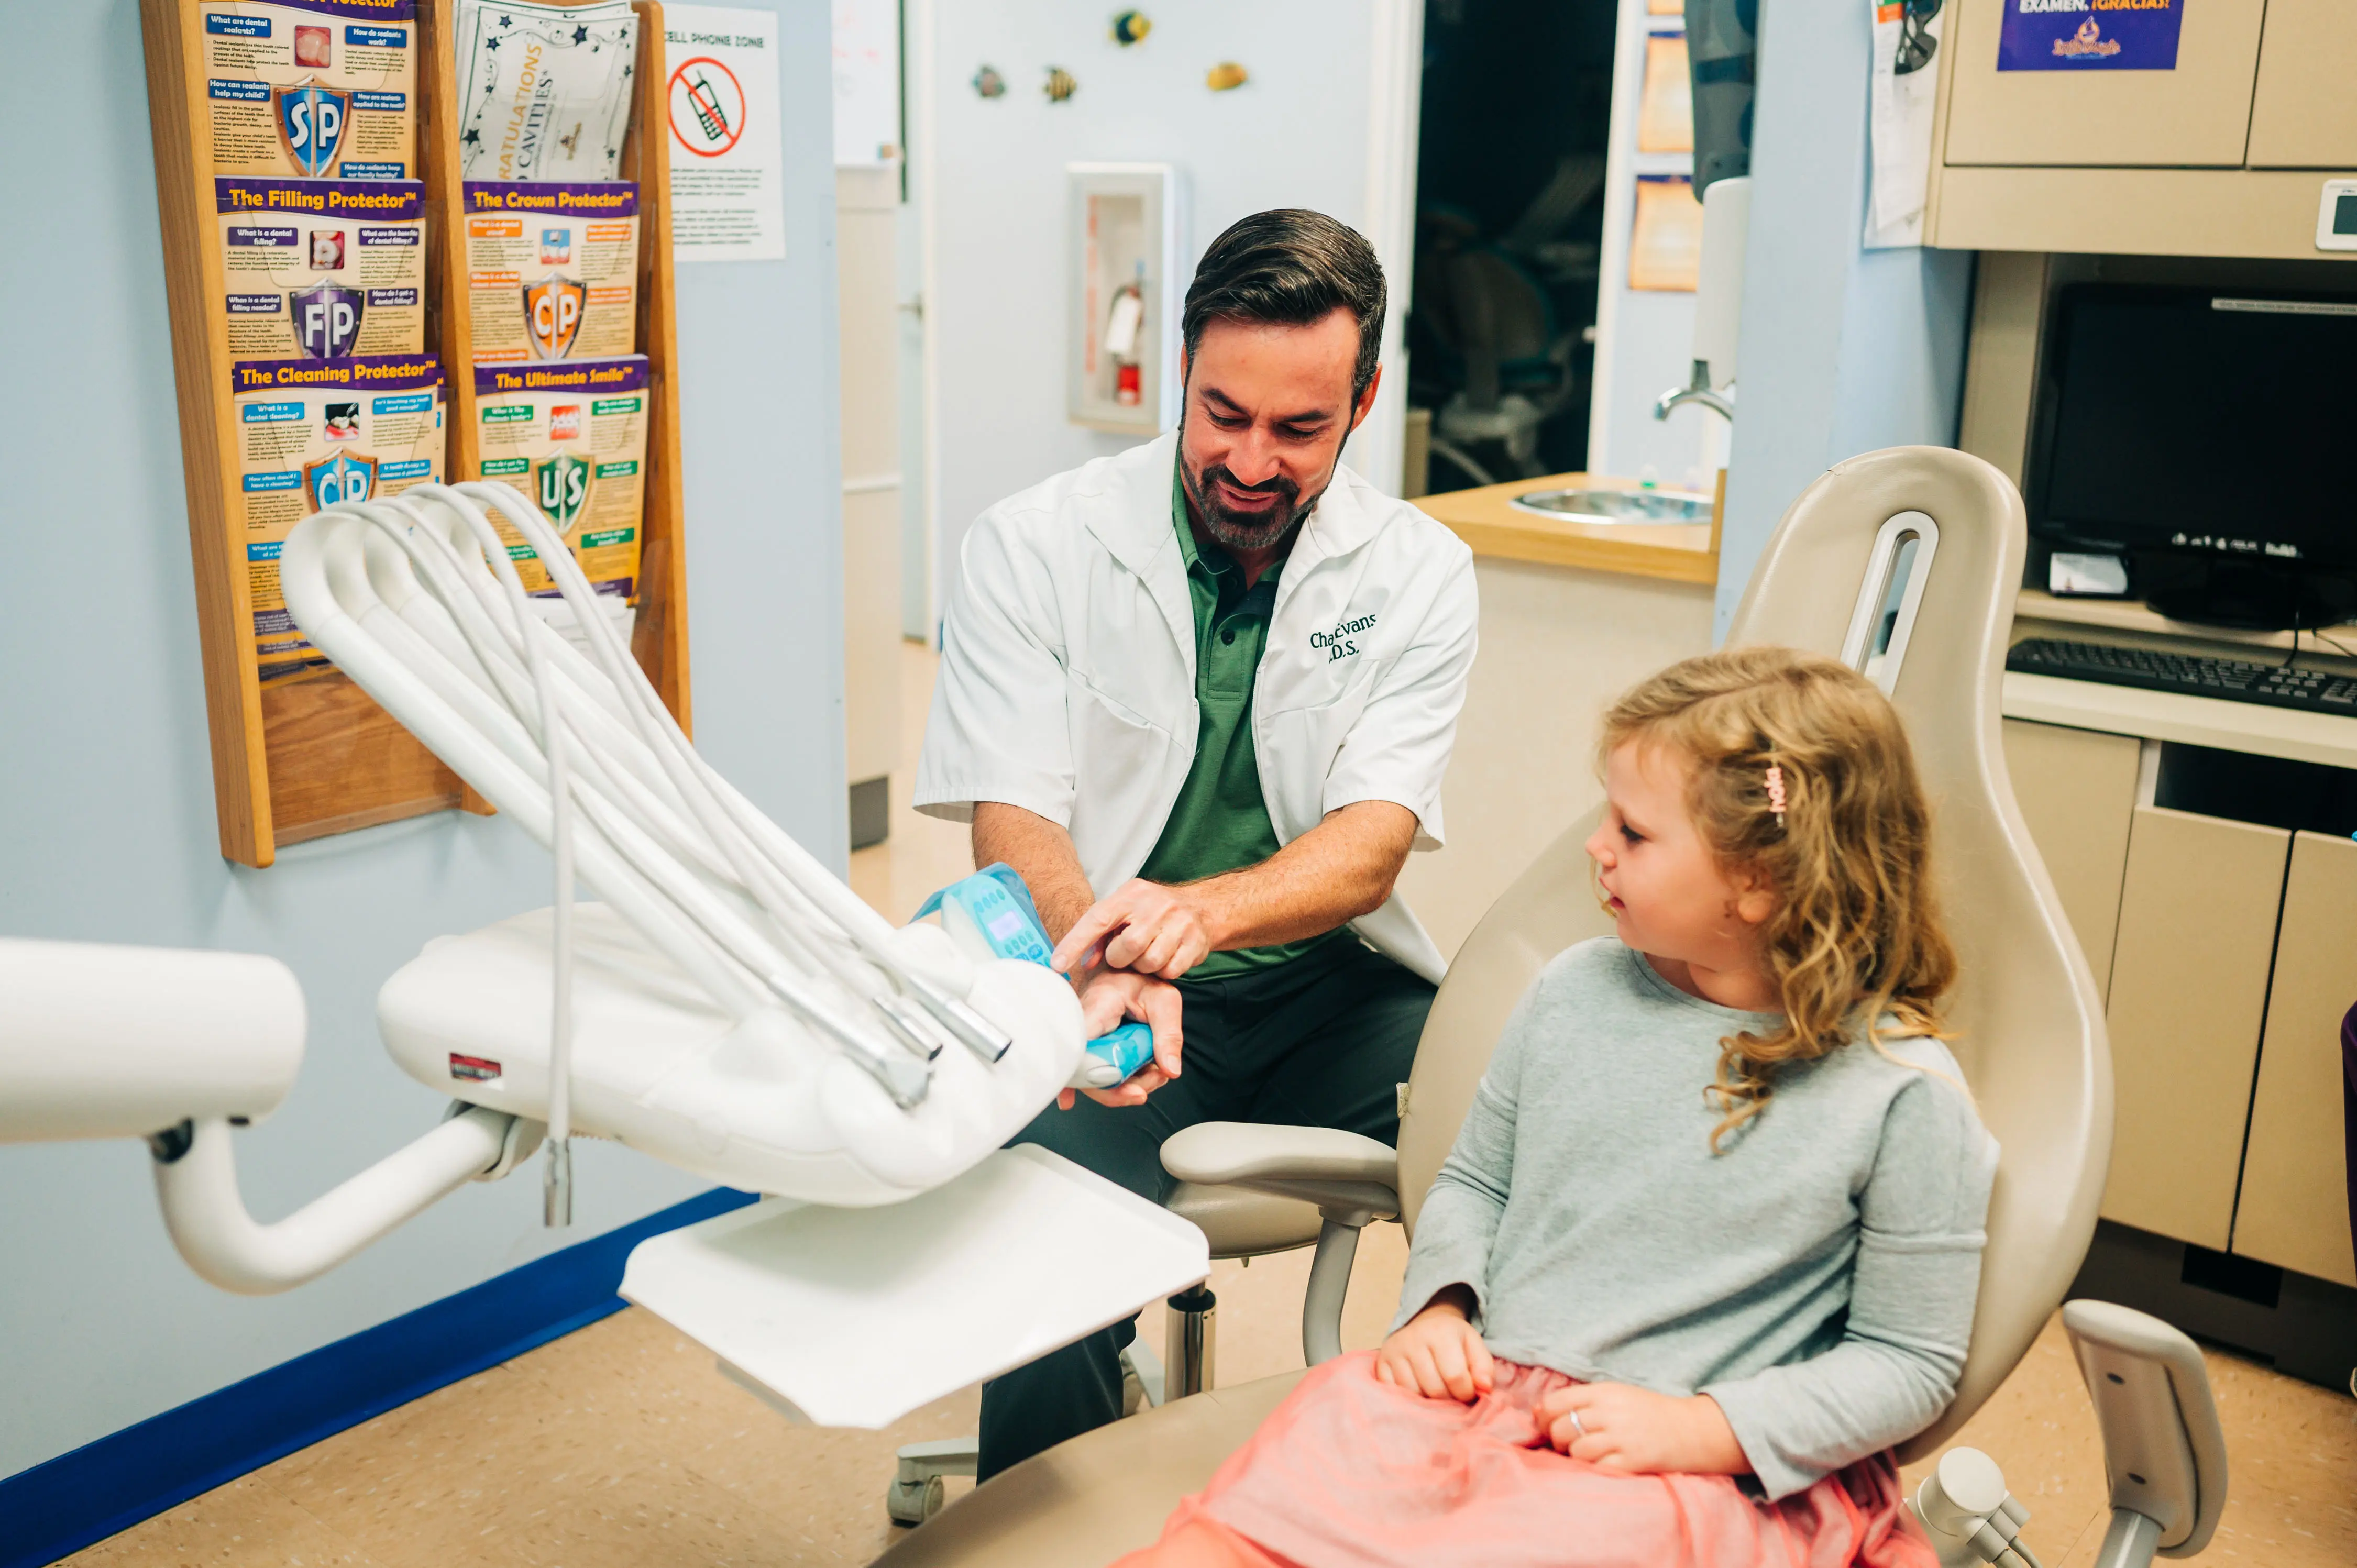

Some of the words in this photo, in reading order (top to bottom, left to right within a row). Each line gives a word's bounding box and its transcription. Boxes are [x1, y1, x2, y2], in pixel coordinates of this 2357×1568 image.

[691, 32, 731, 46] PHONE
[735, 36, 764, 48] ZONE
[215, 90, 230, 98] help
[291, 102, 340, 149] SP
[229, 189, 263, 206] The
[268, 191, 324, 210] Filling
[329, 191, 416, 208] Protector™
[473, 192, 503, 207] The
[506, 192, 555, 207] Crown
[305, 302, 354, 347] FP
[241, 369, 272, 384] The
[277, 365, 349, 383] Cleaning
[354, 360, 436, 380] Protector™
[495, 373, 522, 389] The
[526, 371, 587, 387] Ultimate
[542, 466, 583, 509] US
